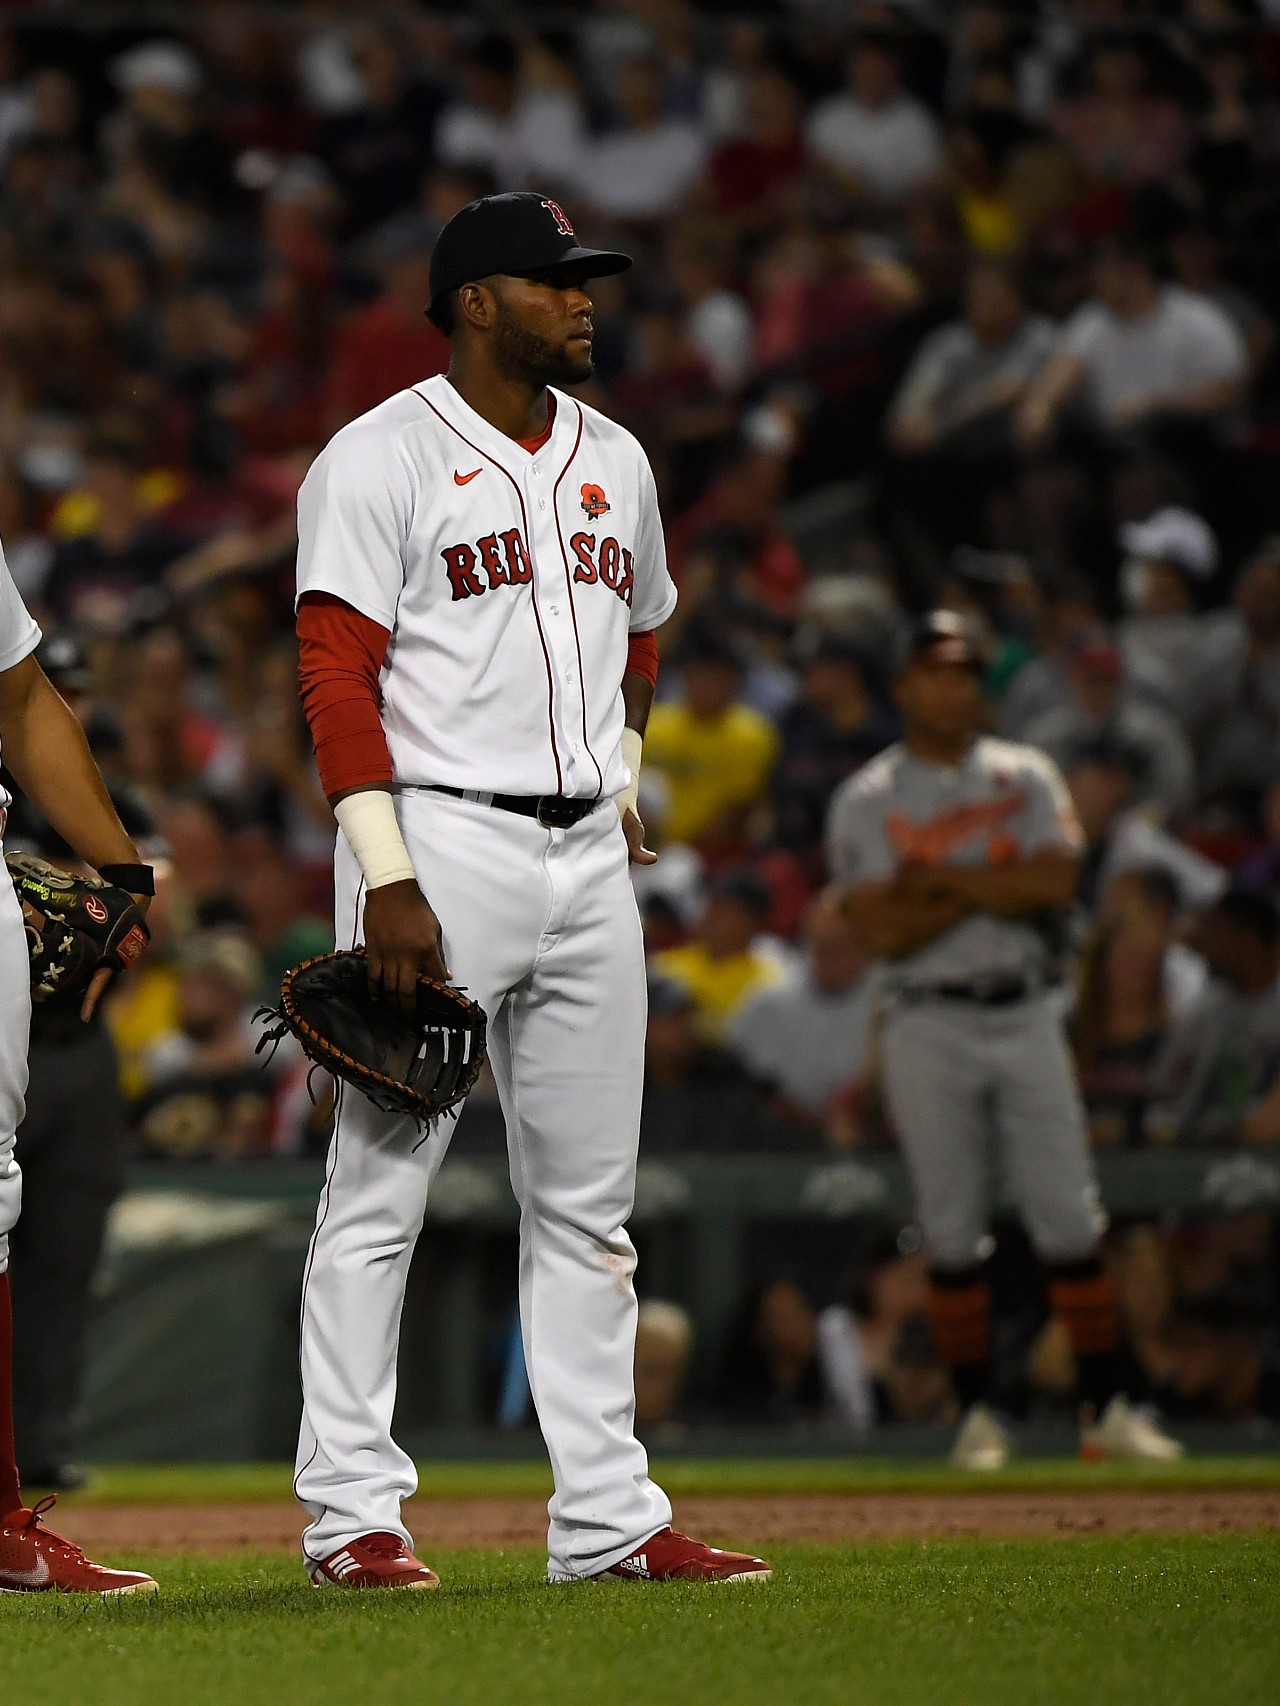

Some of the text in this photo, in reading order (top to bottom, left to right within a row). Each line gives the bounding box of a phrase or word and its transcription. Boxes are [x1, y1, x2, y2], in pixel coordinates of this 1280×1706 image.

[540, 200, 574, 236] B
[440, 527, 534, 602] RED
[620, 1561, 651, 1579] adidas
